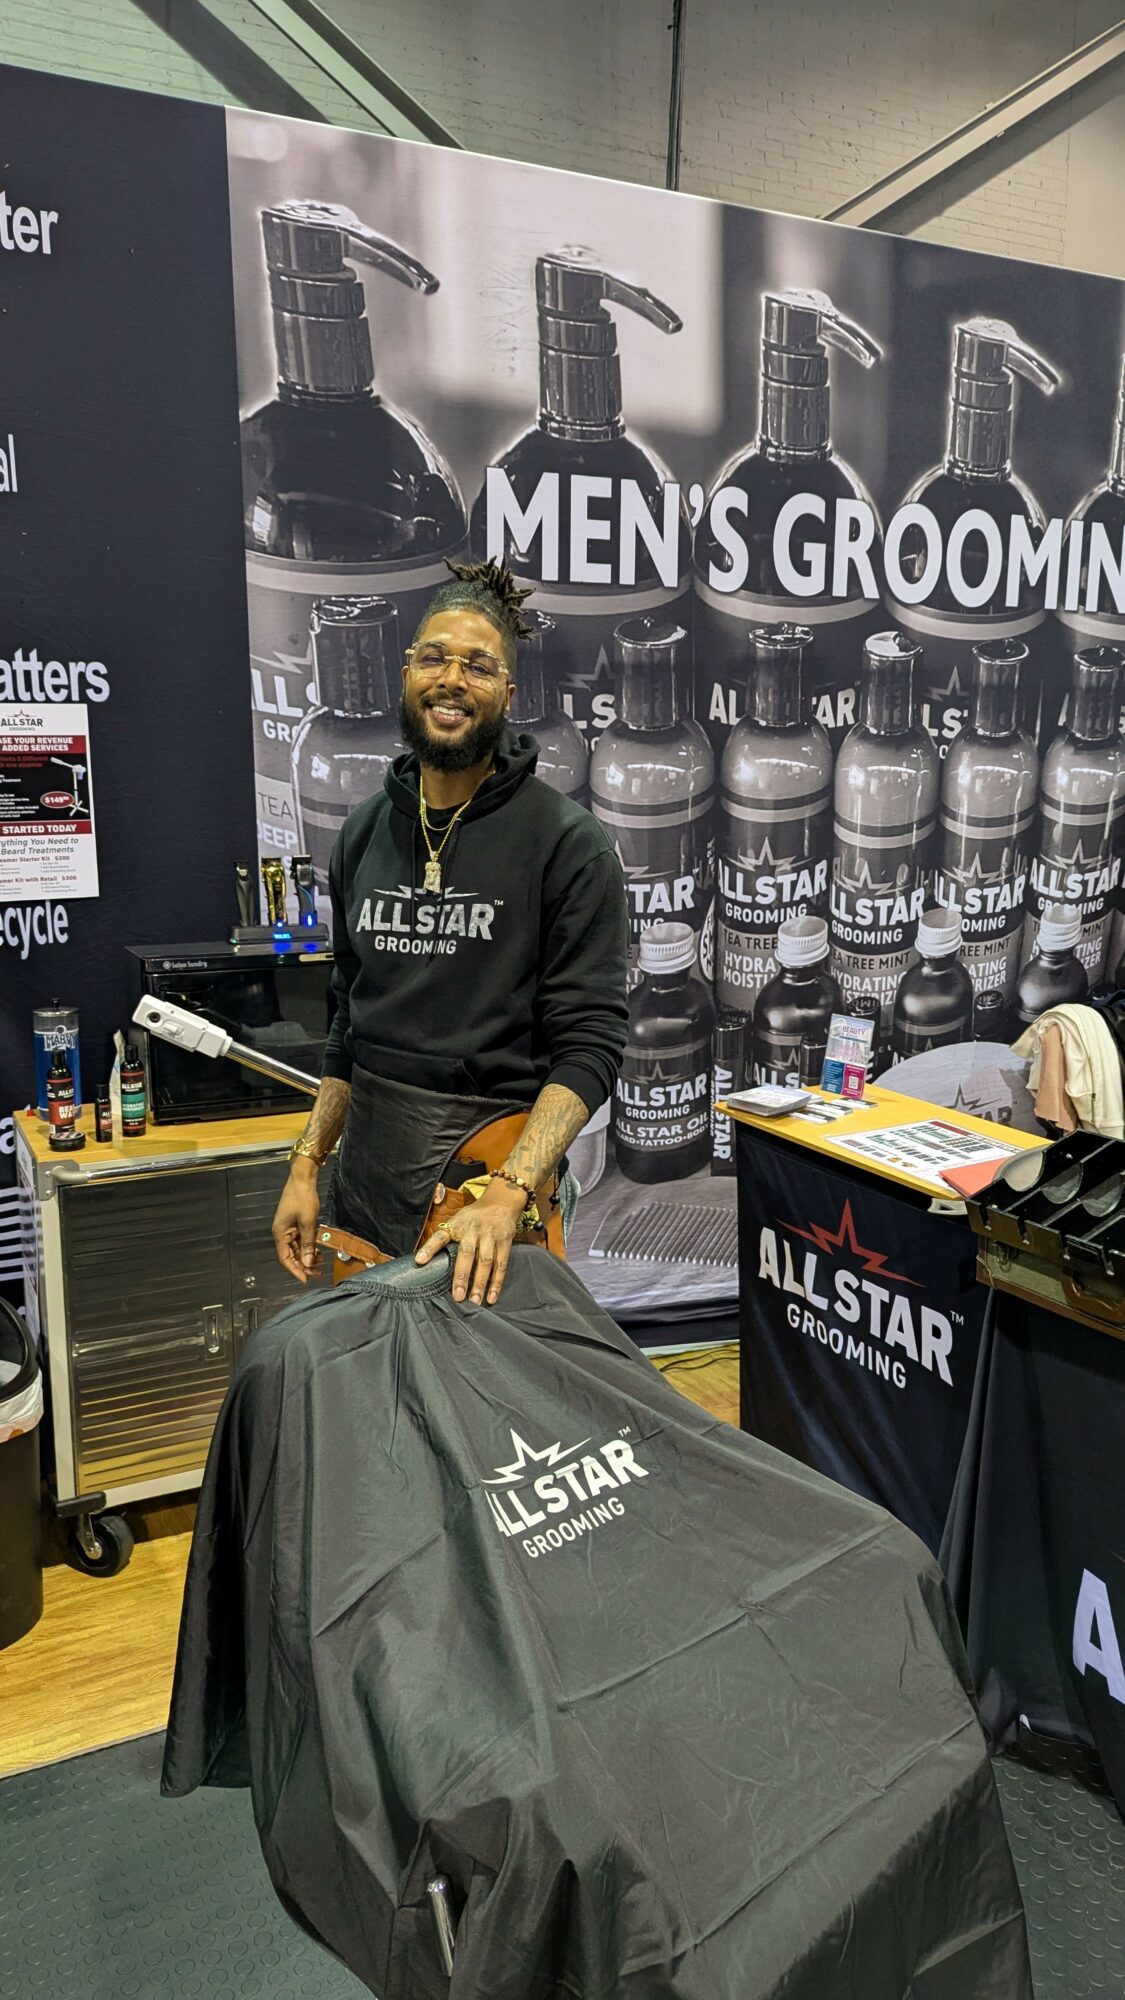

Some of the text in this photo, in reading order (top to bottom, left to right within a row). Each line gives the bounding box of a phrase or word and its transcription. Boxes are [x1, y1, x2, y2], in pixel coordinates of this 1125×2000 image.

[485, 466, 1125, 613] MEN'S GROOMIN
[257, 791, 294, 821] TEA
[2, 824, 77, 834] STARTED TODAY
[0, 838, 28, 848] ything
[31, 838, 46, 846] You
[48, 837, 69, 845] Need
[1, 846, 75, 856] Beard Treatments
[0, 898, 69, 960] cycle
[831, 919, 904, 945] GROOMING
[961, 915, 1007, 933] OMING
[374, 934, 458, 955] GROOMING
[723, 928, 778, 950] TEA TREE
[959, 935, 1011, 958] REE MINT
[846, 954, 875, 971] TREE
[878, 951, 911, 970] MINT
[842, 1025, 866, 1036] BEAUTY
[625, 1104, 690, 1120] GROOMING
[637, 1124, 683, 1138] STAR
[687, 1111, 710, 1131] OIL
[786, 1302, 907, 1389] GROOMING
[522, 1496, 626, 1559] GROOMING
